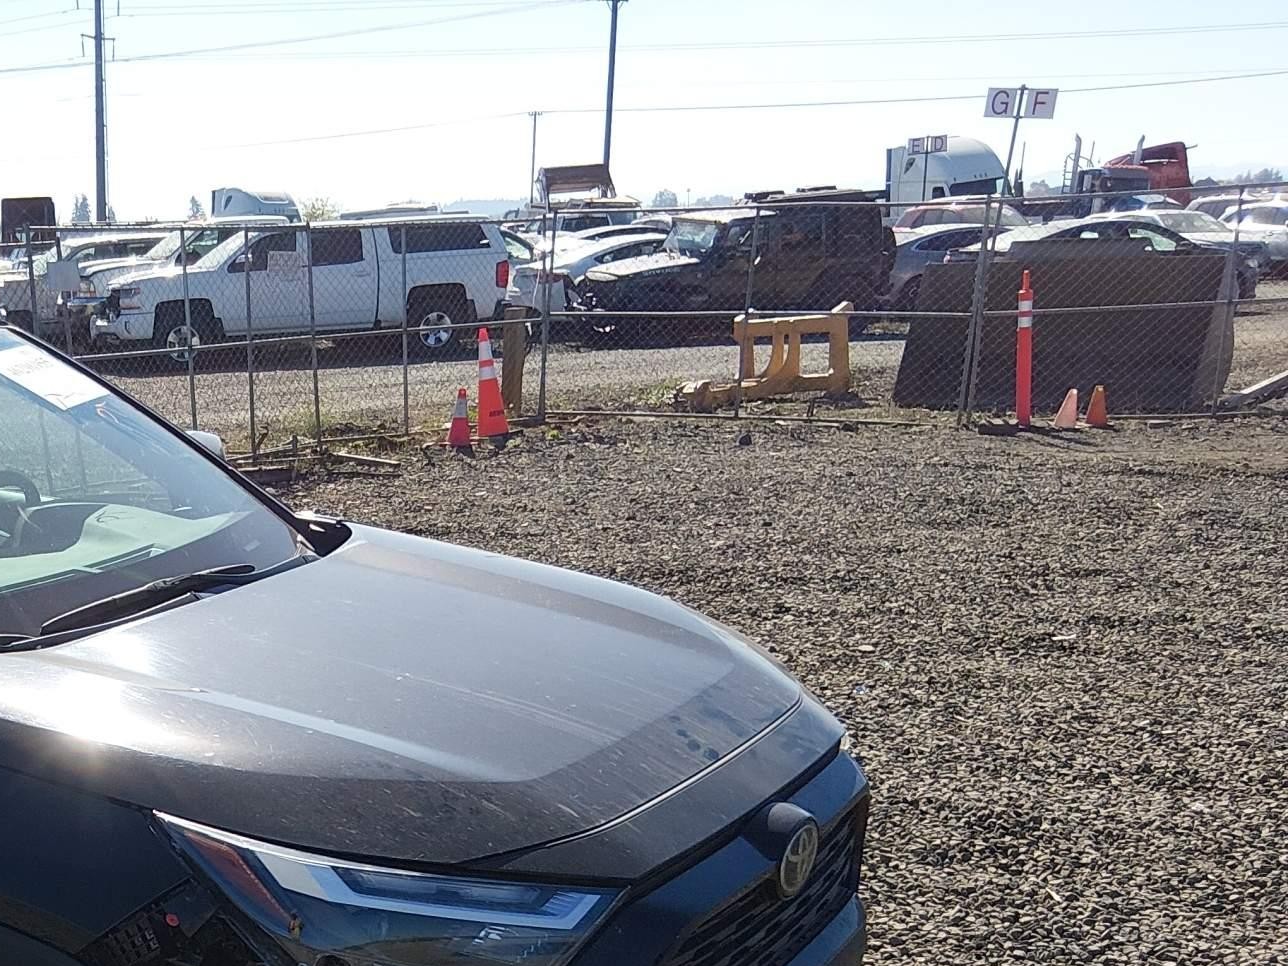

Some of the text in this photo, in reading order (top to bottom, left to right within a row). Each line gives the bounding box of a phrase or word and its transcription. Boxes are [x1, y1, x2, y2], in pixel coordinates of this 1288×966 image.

[991, 90, 1010, 115] G
[1032, 91, 1049, 115] F
[912, 138, 921, 153] E
[934, 136, 944, 151] D
